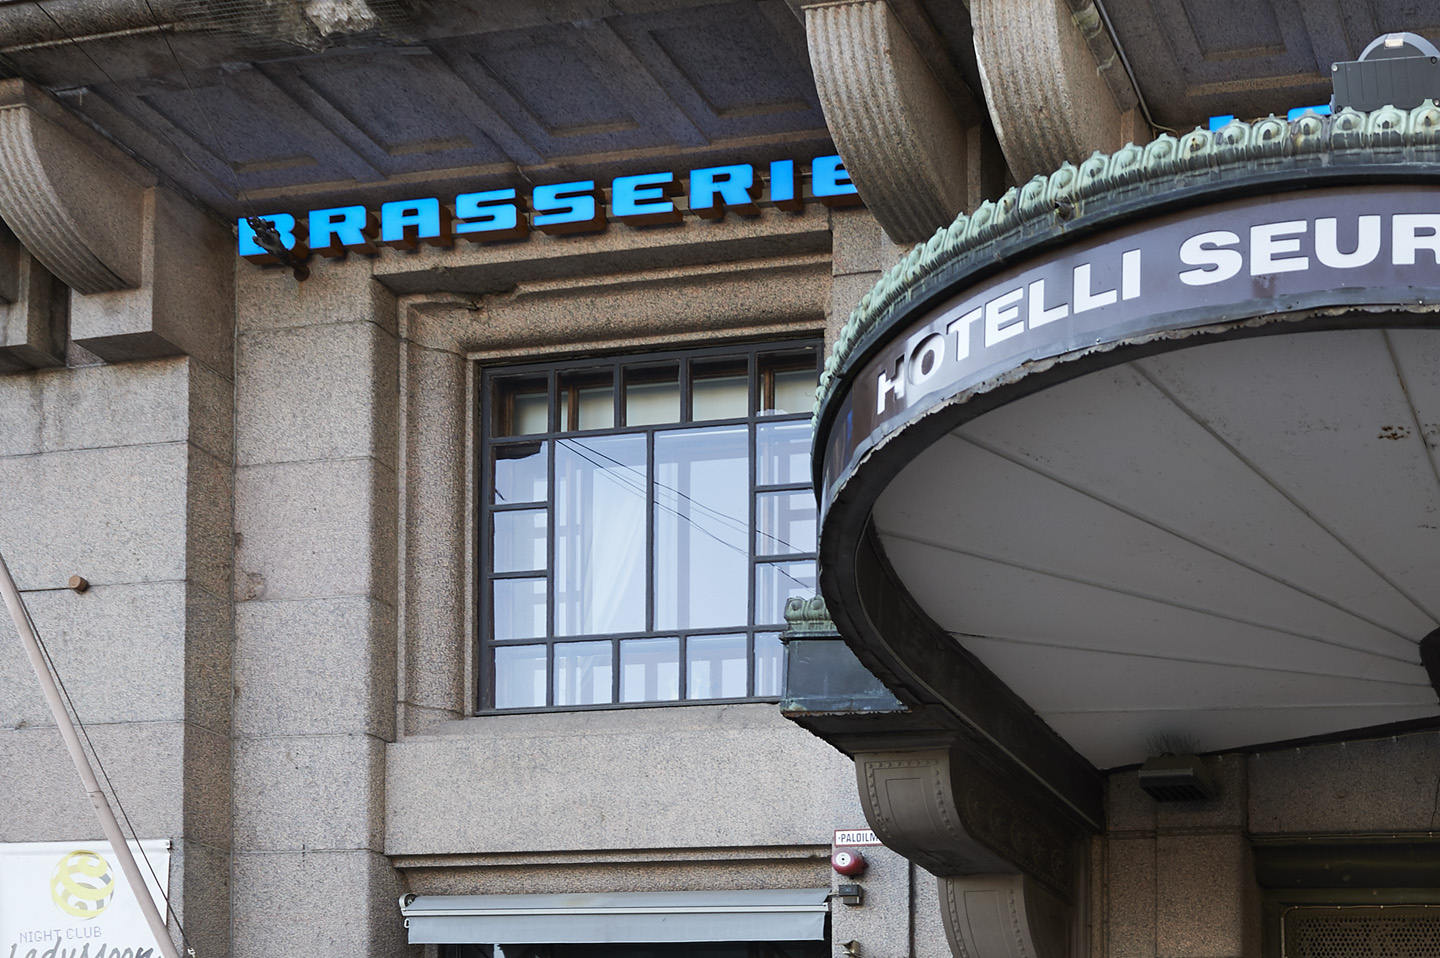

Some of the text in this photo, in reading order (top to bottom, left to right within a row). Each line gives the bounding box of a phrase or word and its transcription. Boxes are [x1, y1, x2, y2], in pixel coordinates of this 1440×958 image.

[237, 154, 858, 257] BRASSERIE
[875, 248, 1142, 416] HOTELLI
[19, 925, 103, 943] NIGHT CLUB
